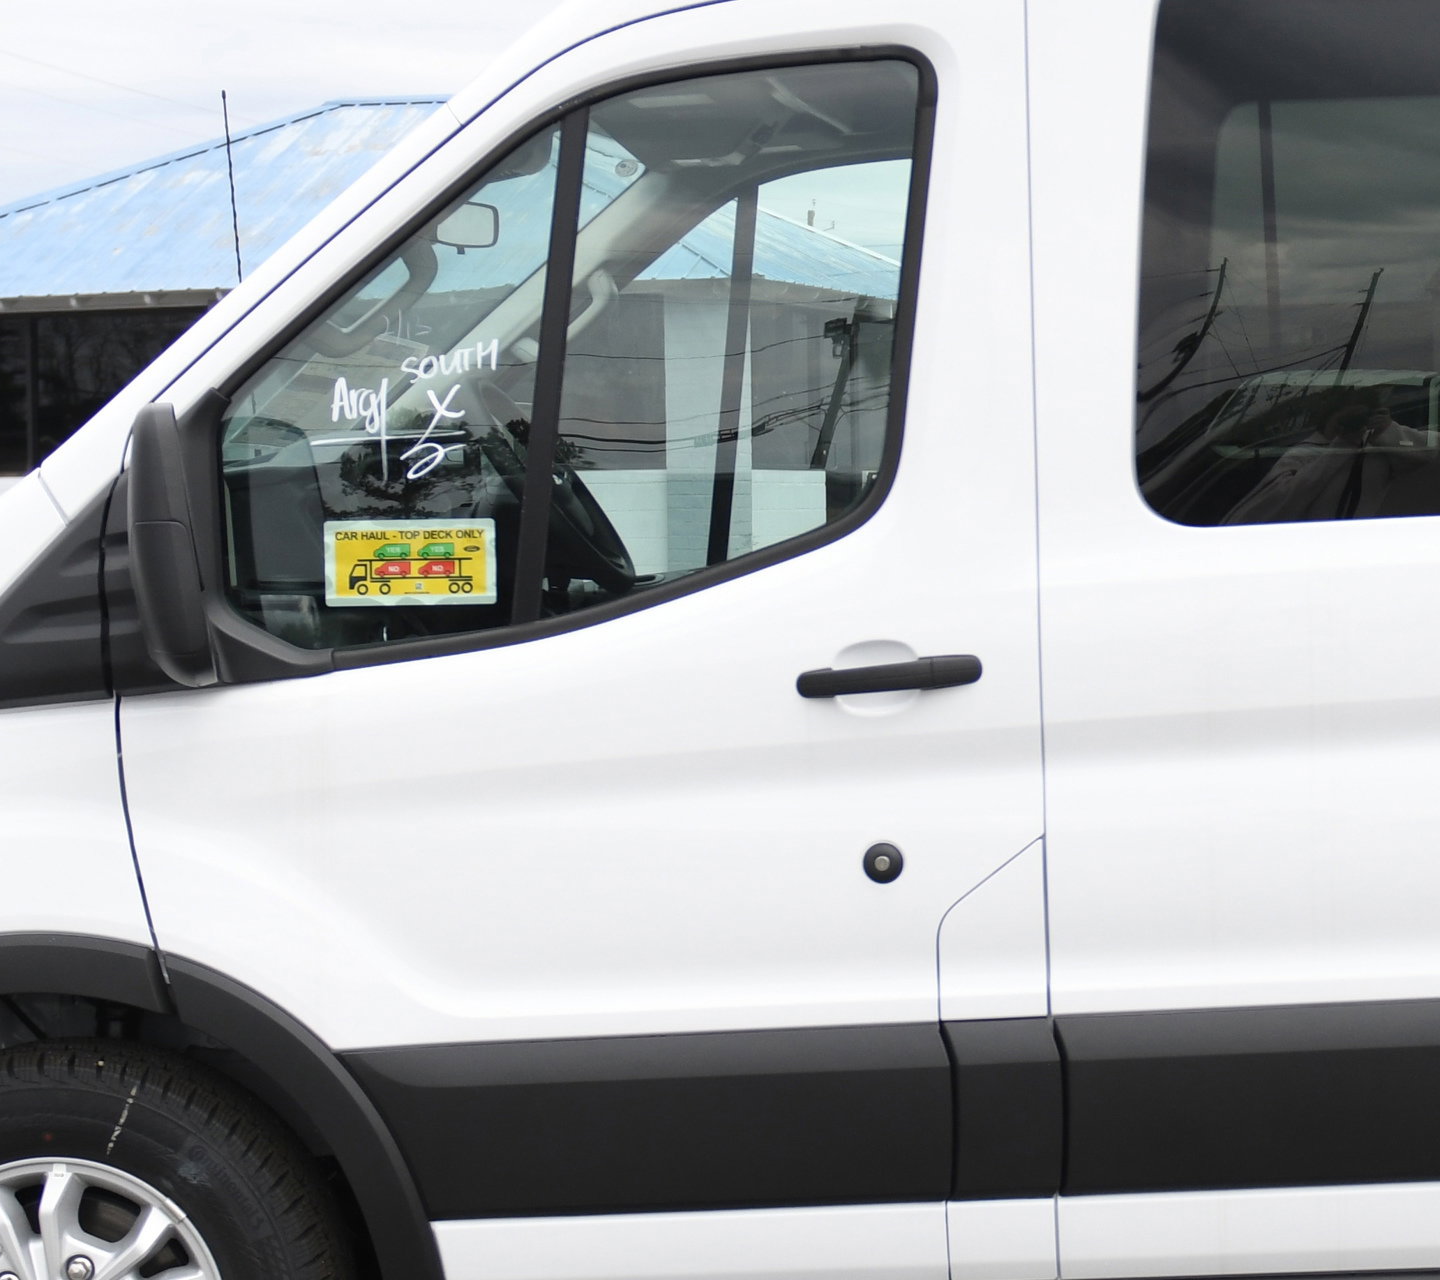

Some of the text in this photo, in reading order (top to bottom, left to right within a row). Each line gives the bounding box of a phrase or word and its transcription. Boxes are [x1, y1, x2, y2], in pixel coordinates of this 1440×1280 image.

[335, 531, 358, 541] CAR
[361, 531, 389, 540] HAUL
[398, 530, 420, 540] TOP
[423, 530, 453, 540] DECK
[456, 529, 485, 539] ONLY
